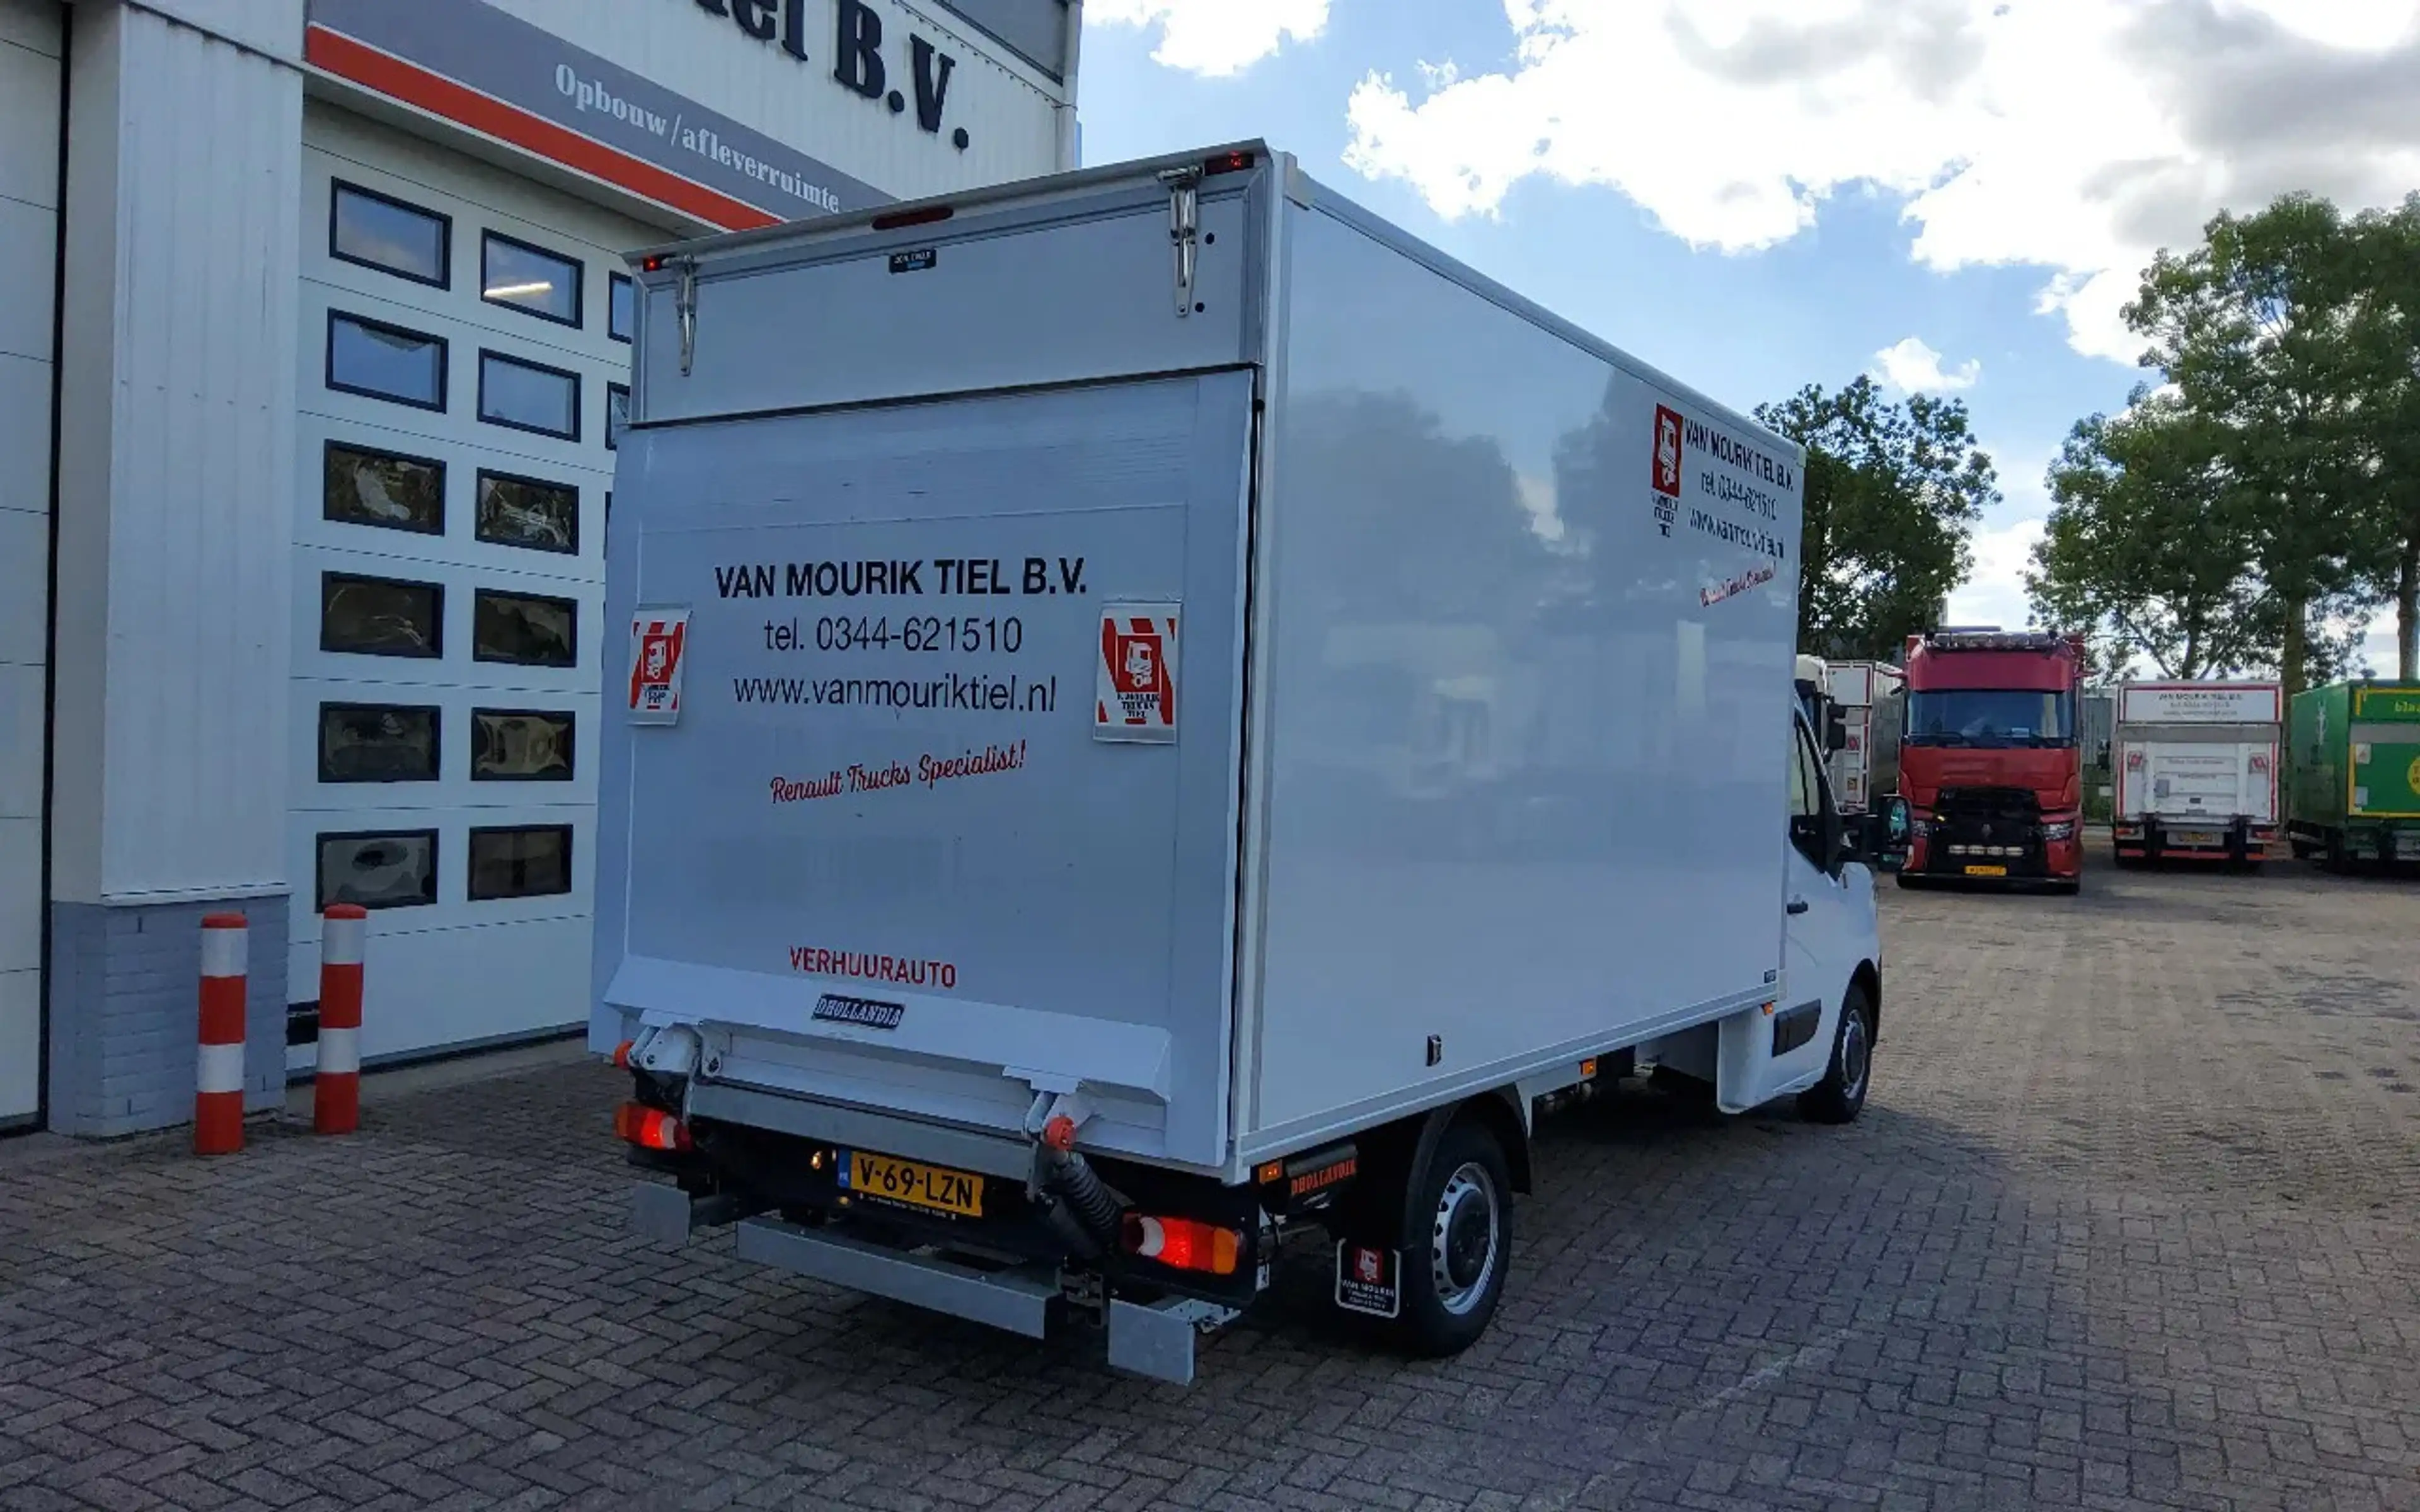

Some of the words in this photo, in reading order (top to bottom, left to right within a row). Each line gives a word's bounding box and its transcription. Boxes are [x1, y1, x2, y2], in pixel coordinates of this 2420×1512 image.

[833, 0, 969, 150] B.V.
[1685, 418, 1708, 452] VAN
[1755, 453, 1775, 483] TIEL
[714, 564, 776, 598] VAN
[786, 559, 924, 597] MOURIK
[934, 558, 1011, 594] TIEL
[1022, 557, 1086, 594] B.V.
[764, 617, 805, 651] tel.
[816, 616, 1022, 653] 0344-621510
[734, 672, 1056, 712] www.vanmouriktiel.nl
[769, 770, 844, 804] Renault
[847, 760, 911, 793] Trucks
[918, 738, 1027, 790] Specialist!
[789, 945, 957, 988] VERHUURAUTO
[813, 997, 903, 1026] DHOLLANDIA
[860, 1158, 974, 1209] V-69-LZN
